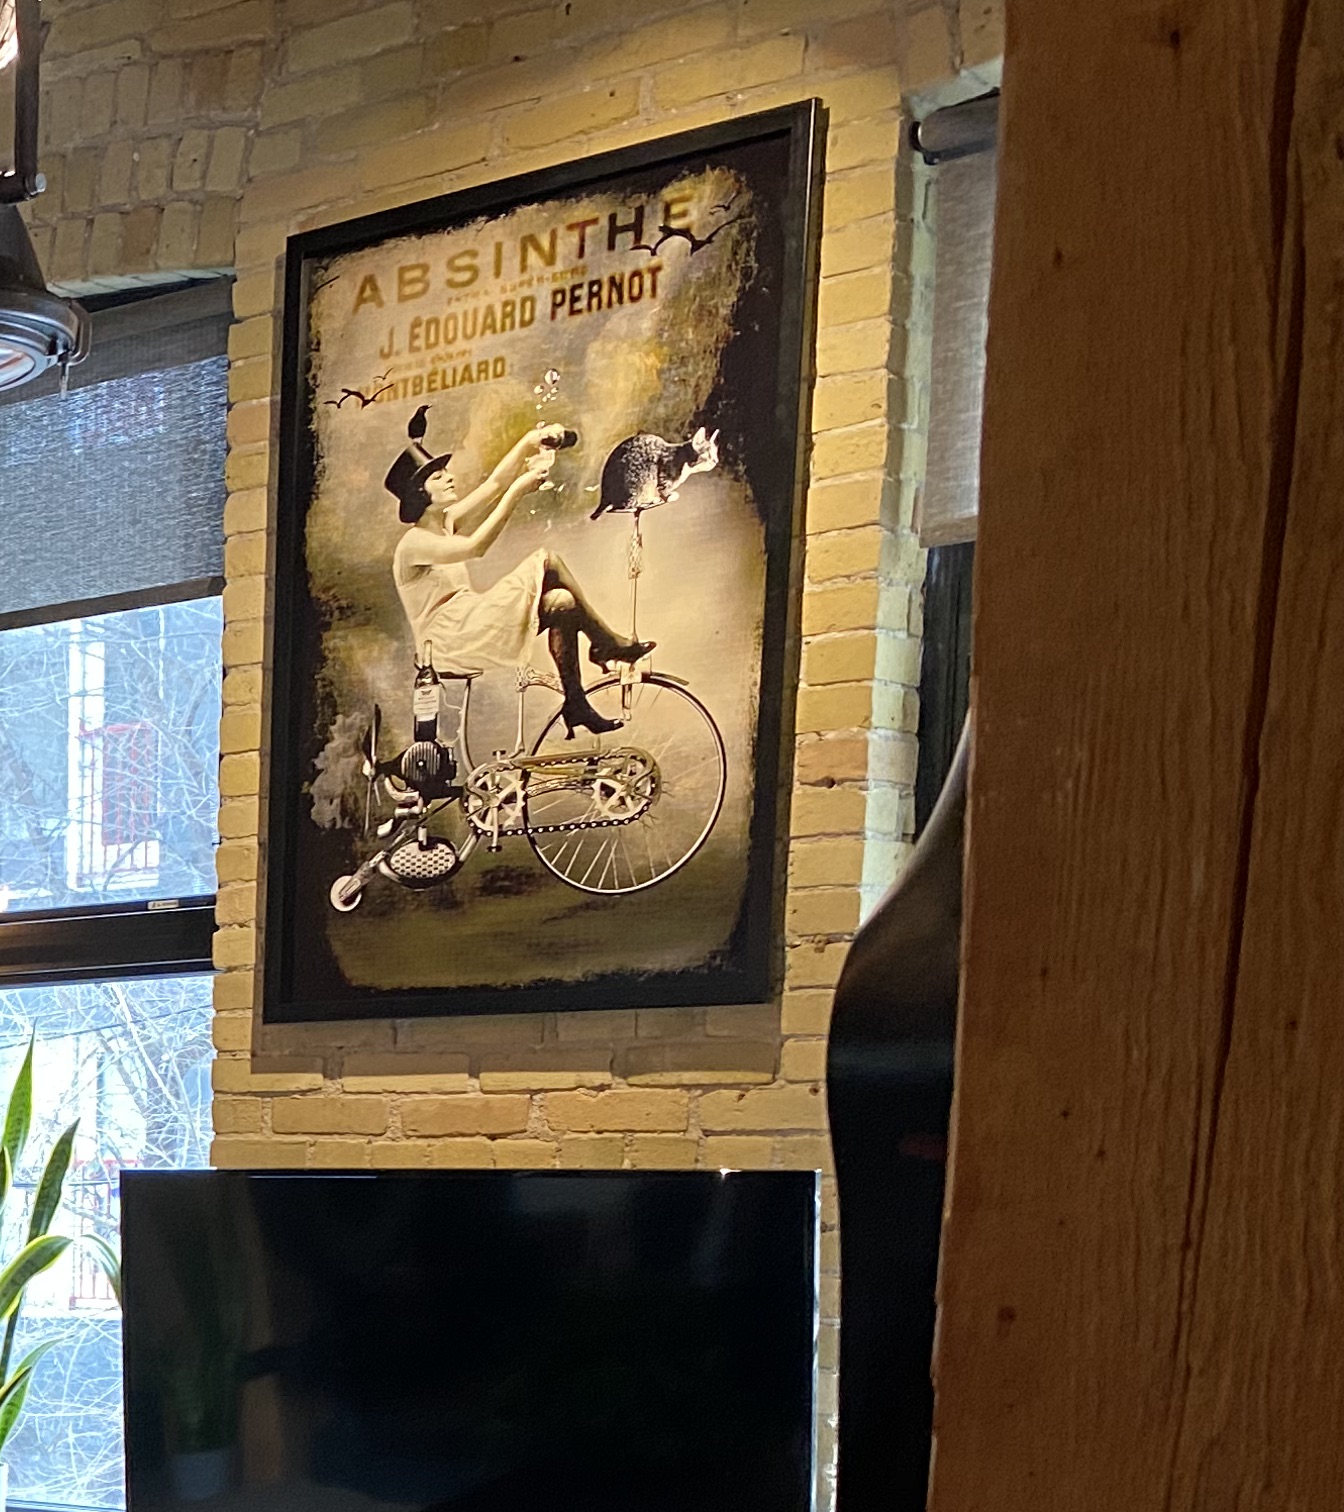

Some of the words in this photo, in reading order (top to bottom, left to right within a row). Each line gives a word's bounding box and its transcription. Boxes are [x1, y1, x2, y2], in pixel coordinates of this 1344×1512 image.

[351, 195, 694, 316] ABSINTHE
[408, 294, 537, 353] ÉDOUARD
[550, 264, 663, 320] PERNOT
